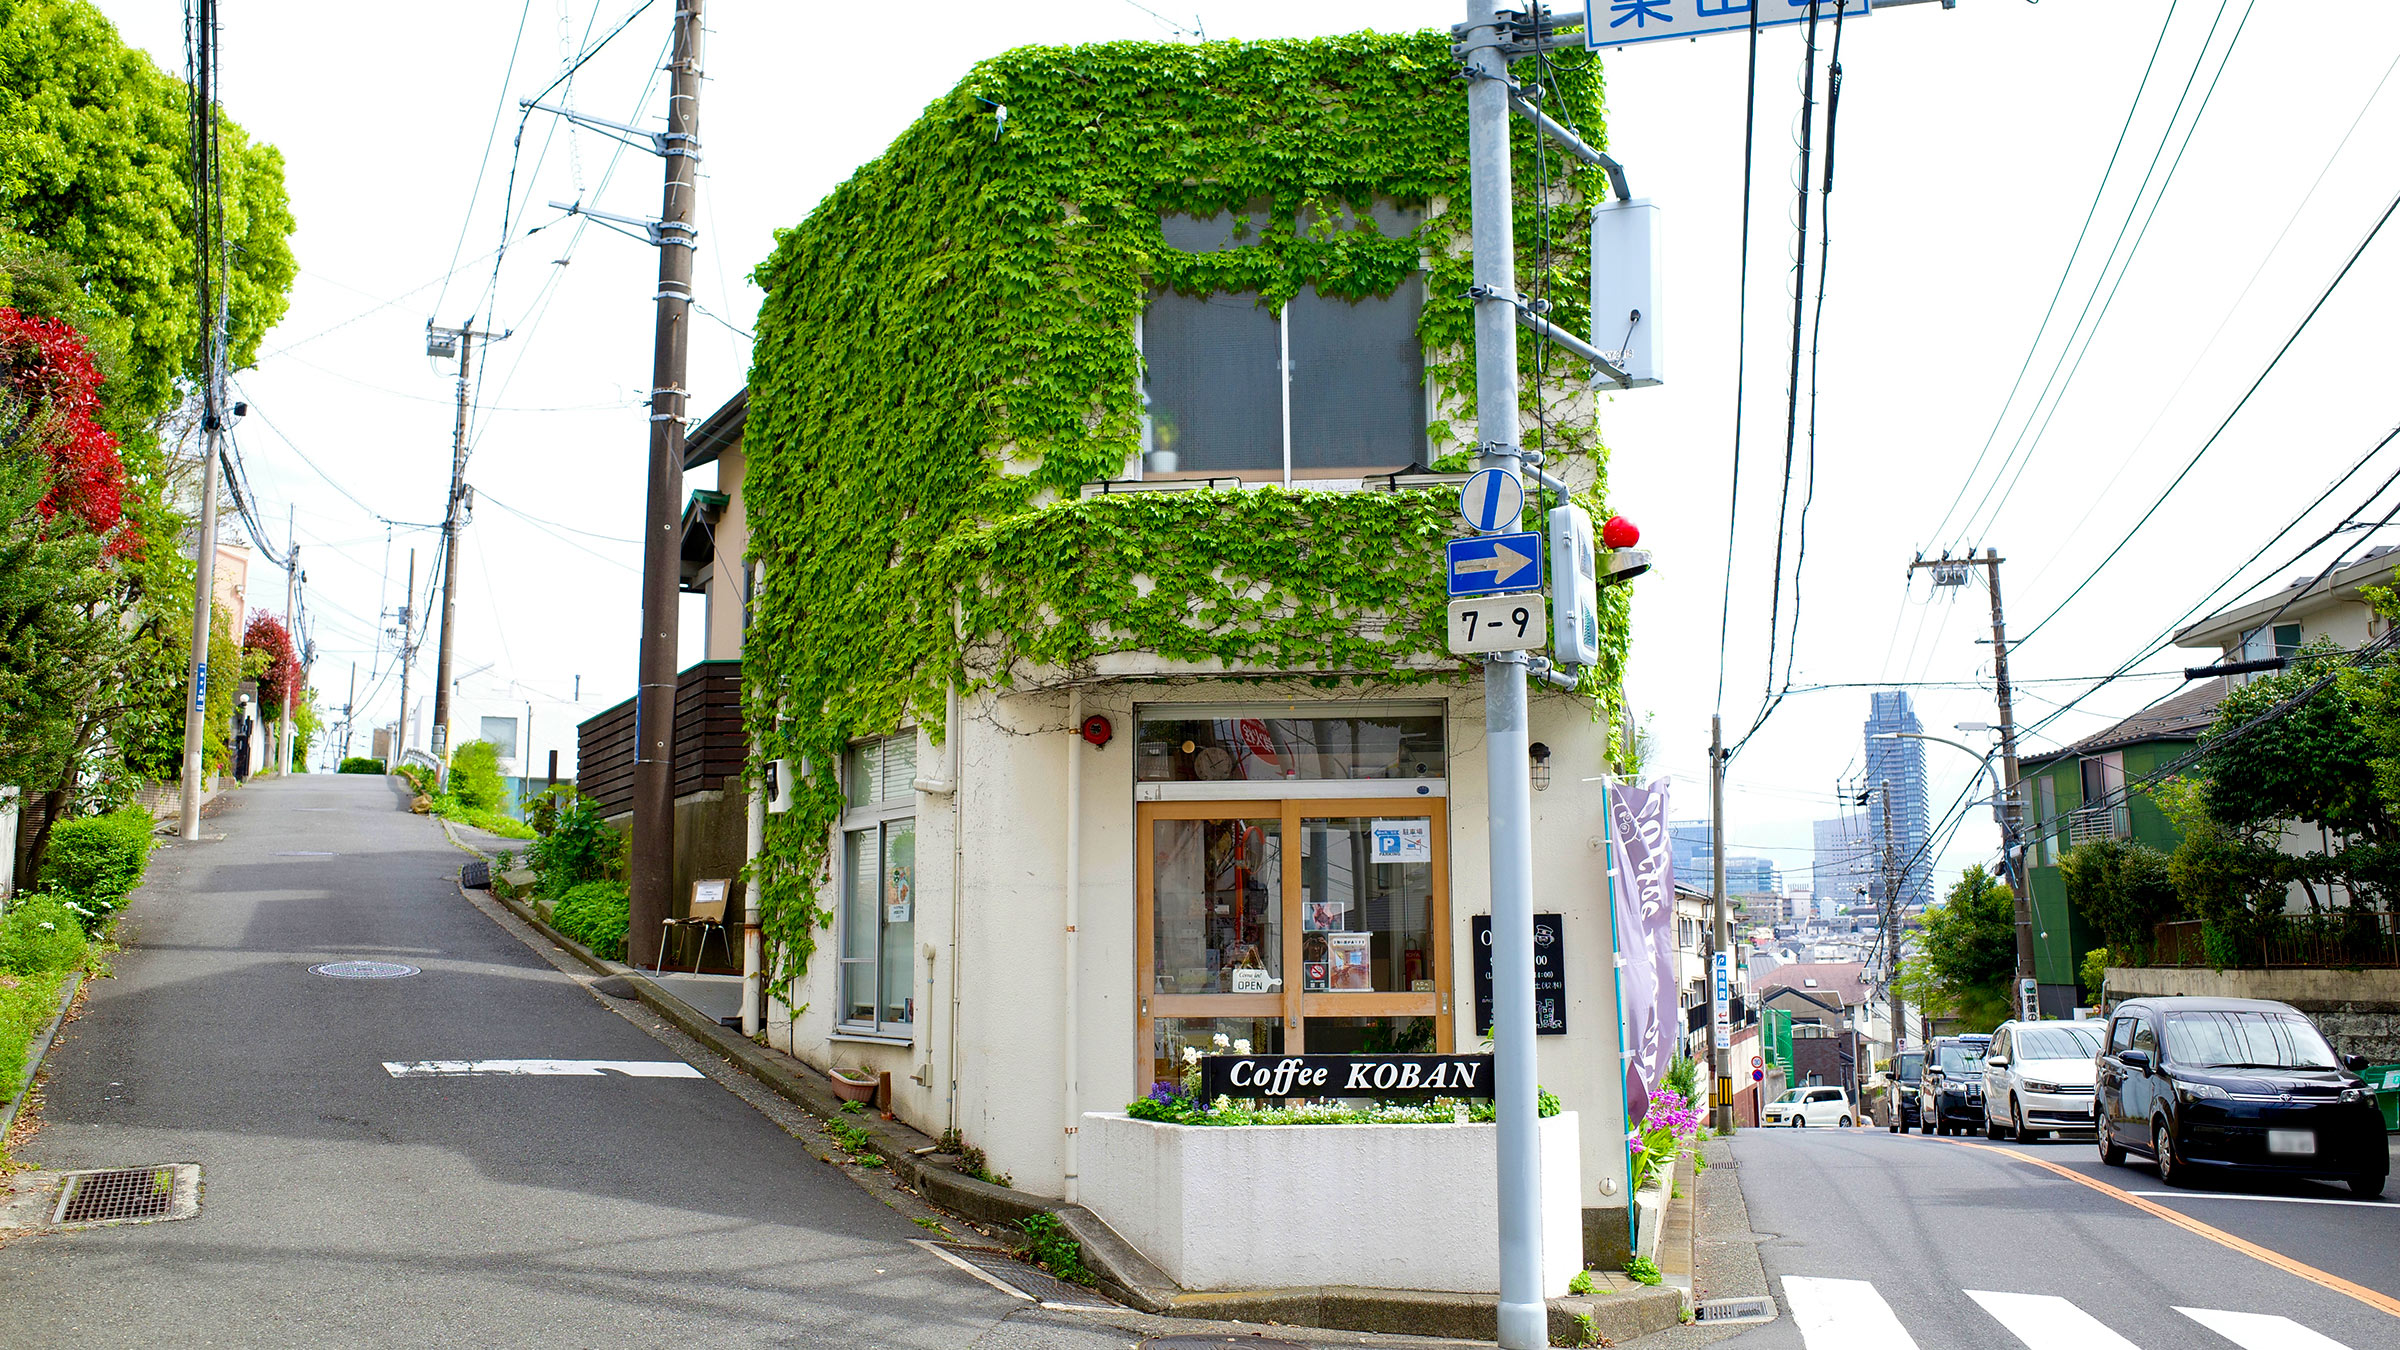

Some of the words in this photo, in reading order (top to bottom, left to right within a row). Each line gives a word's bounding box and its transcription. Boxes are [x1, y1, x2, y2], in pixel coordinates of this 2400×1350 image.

[1461, 607, 1530, 642] 7-9
[1237, 981, 1263, 990] OPEN
[1230, 1058, 1328, 1096] Coffee
[1344, 1062, 1482, 1090] KOBAN
